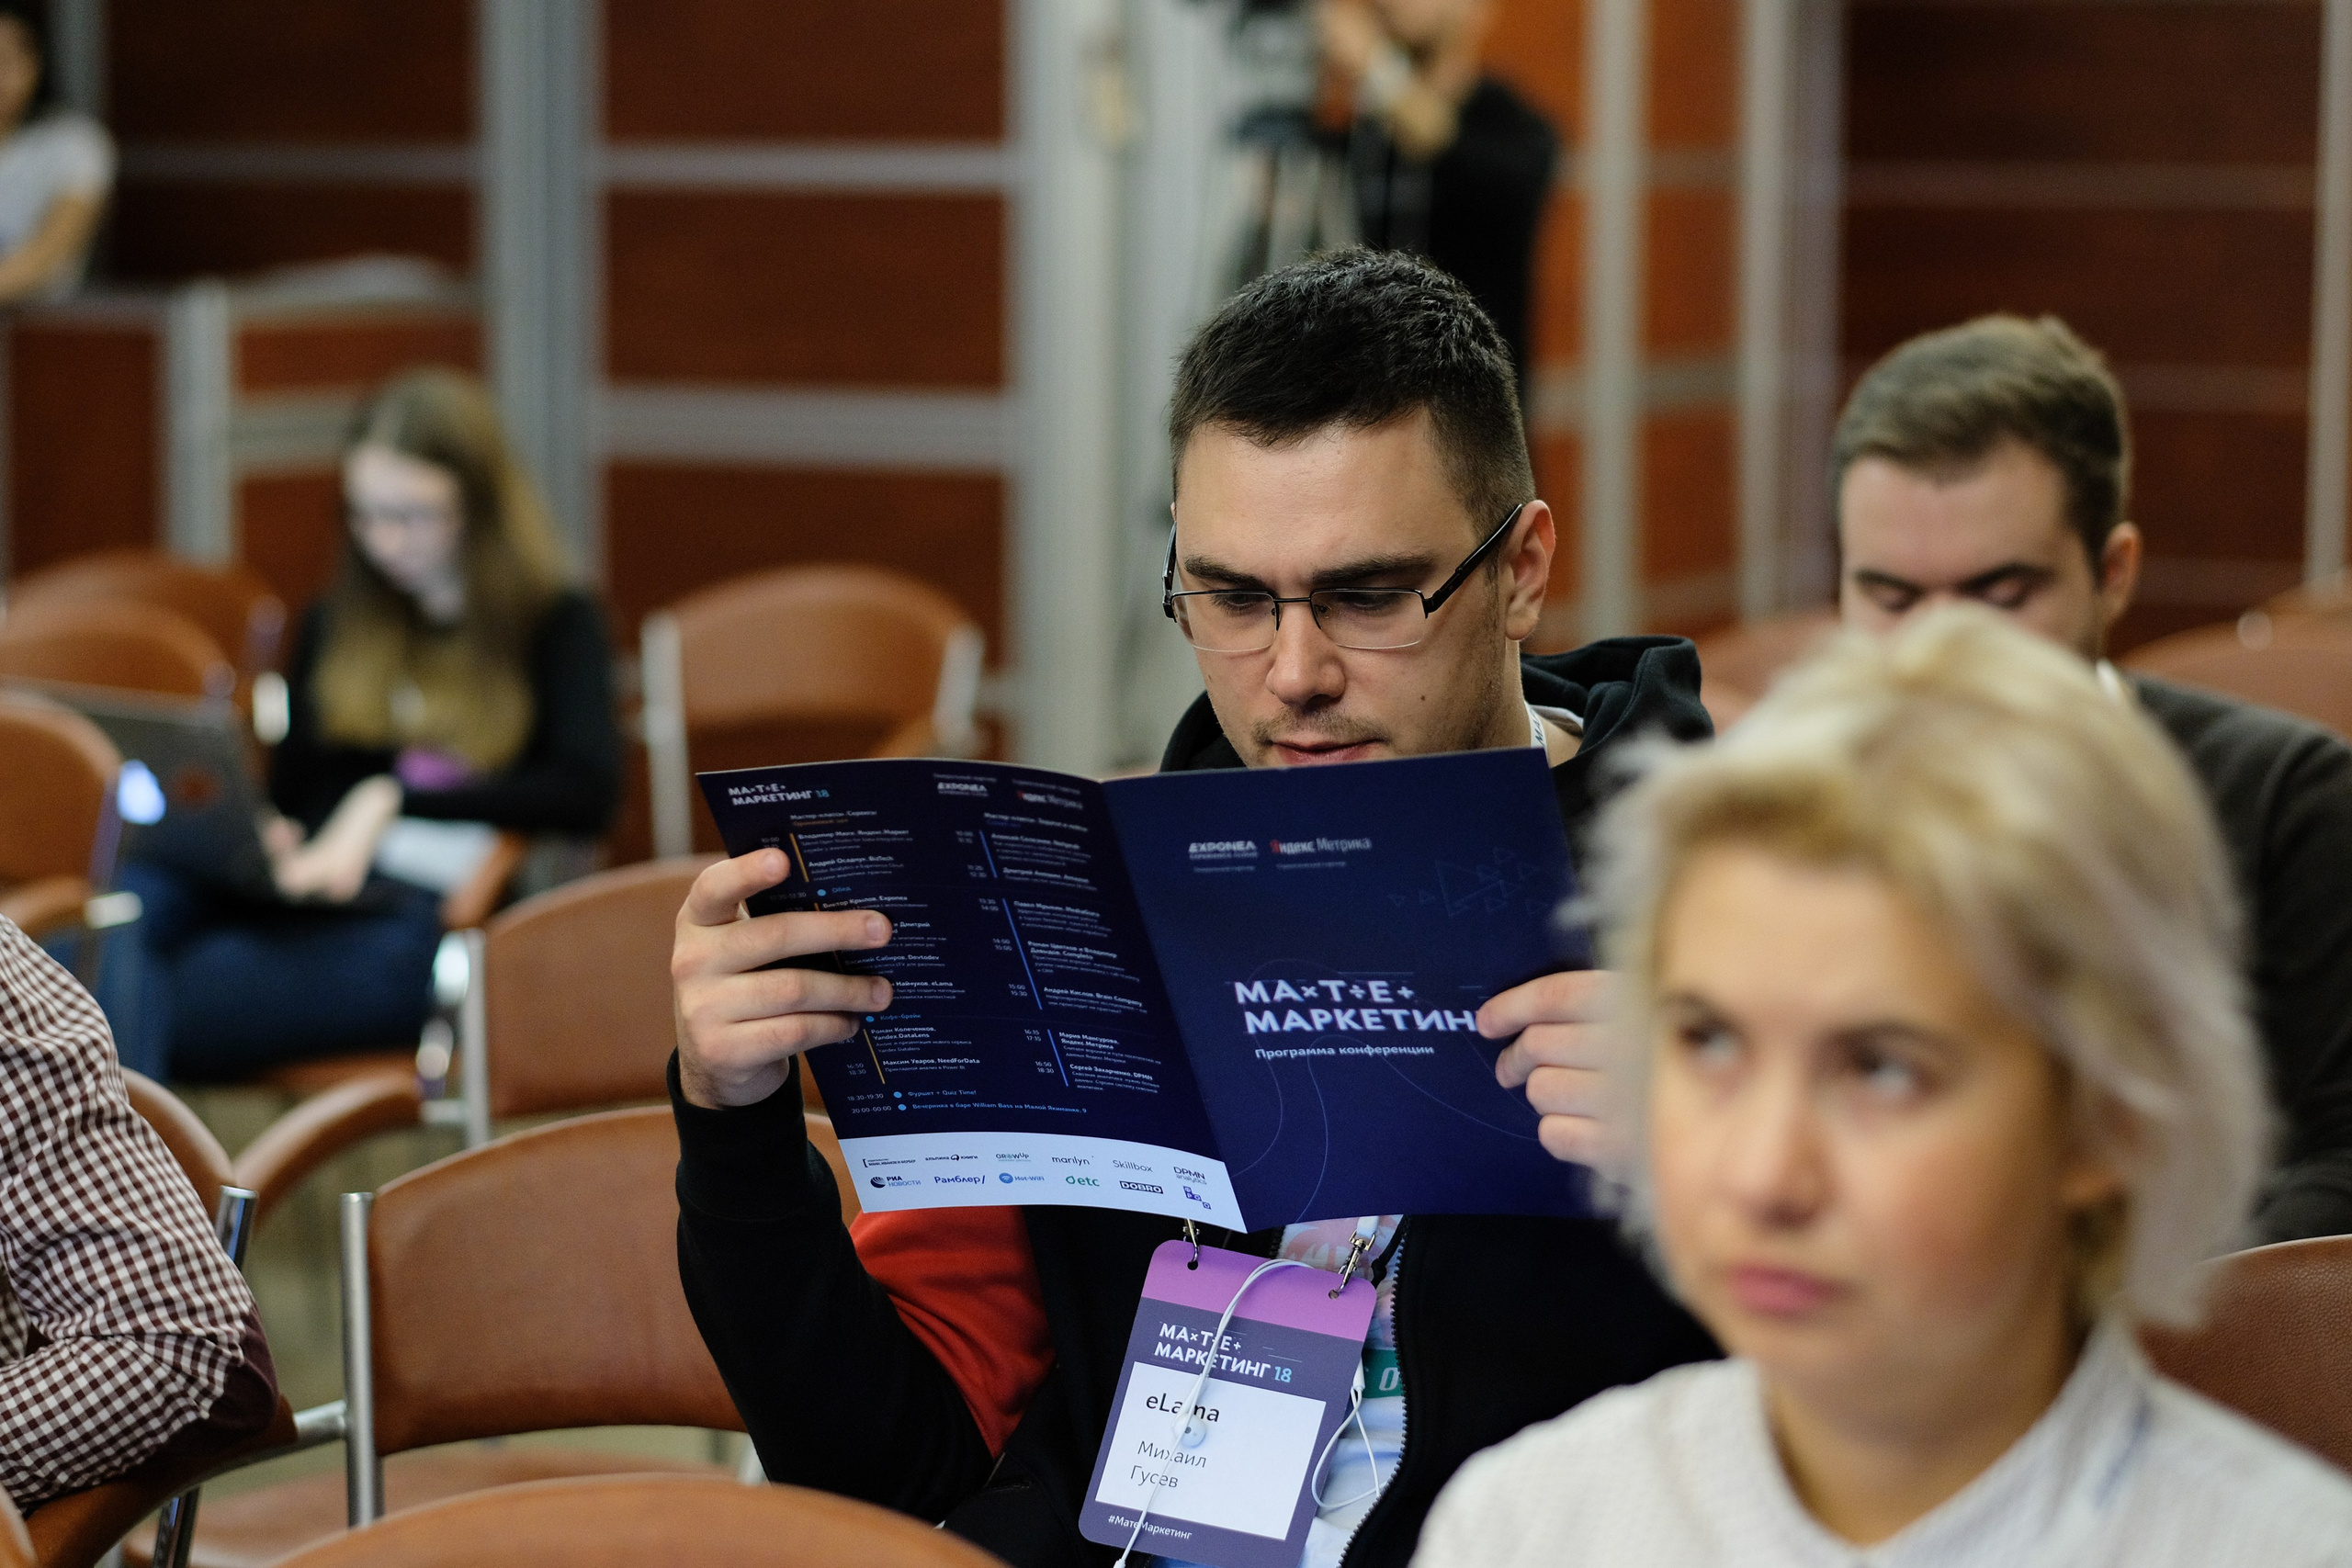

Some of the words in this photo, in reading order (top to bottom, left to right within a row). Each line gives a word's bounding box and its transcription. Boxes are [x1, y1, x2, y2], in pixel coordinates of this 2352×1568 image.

[731, 790, 812, 806] МАРКЕТИНГ
[814, 789, 830, 798] 18
[1244, 1009, 1478, 1034] МАРКЕТИН
[1255, 1045, 1335, 1060] Программа
[1339, 1043, 1435, 1056] конференции
[847, 1093, 884, 1101] 18:30-19:30
[1051, 1156, 1090, 1167] marilyn
[1113, 1159, 1153, 1172] Skillbox
[1173, 1167, 1205, 1179] DPMN
[1121, 1181, 1163, 1193] DOBRO
[1273, 1367, 1292, 1383] 18
[1137, 1440, 1207, 1468] Михаил
[1131, 1465, 1179, 1488] Гусев
[1108, 1514, 1193, 1540] #МатеМаркетинг
